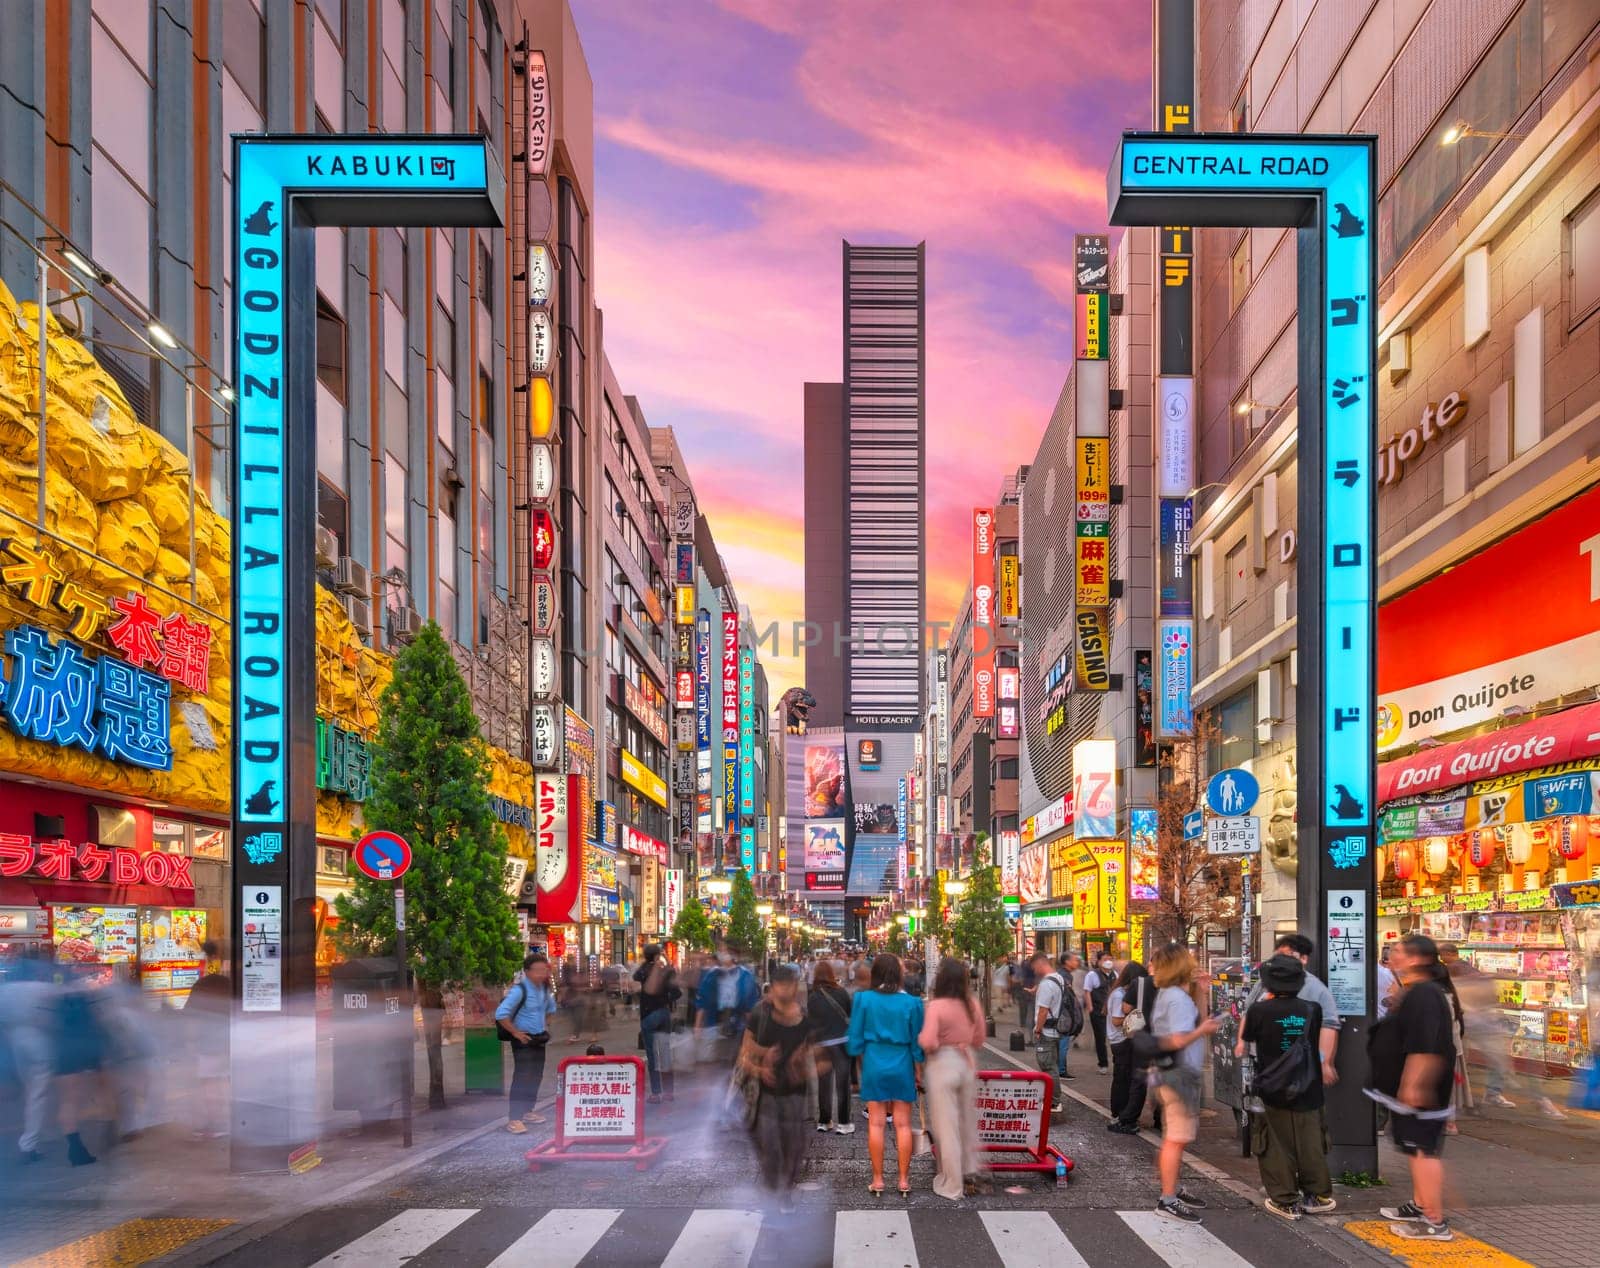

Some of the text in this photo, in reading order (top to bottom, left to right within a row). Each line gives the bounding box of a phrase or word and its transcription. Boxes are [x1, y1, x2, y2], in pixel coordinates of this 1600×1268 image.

[1134, 156, 1329, 176] CENTRAL ROAD
[1084, 442, 1097, 487] 生ビール
[244, 247, 280, 764] GODZILLA ROAD
[1078, 490, 1108, 501] 199円
[1330, 295, 1367, 732] ゴジラロード
[1083, 524, 1103, 537] 4F
[1080, 540, 1105, 585] 麻雀
[723, 616, 736, 723] カラオケ歌広場
[1077, 612, 1108, 684] CASINO
[0, 624, 173, 771] 放題
[880, 716, 914, 724] GRACERY
[1408, 673, 1536, 729] Don Quijote
[537, 753, 548, 761] B1
[1396, 764, 1442, 790] Don
[1449, 735, 1556, 776] Quijote
[1549, 777, 1584, 793] Wi-Fi
[539, 780, 555, 848] トラノコ
[1092, 846, 1123, 854] カラオケ
[569, 1083, 631, 1095] 車両進入禁止
[975, 1098, 1039, 1111] 車両進入禁止
